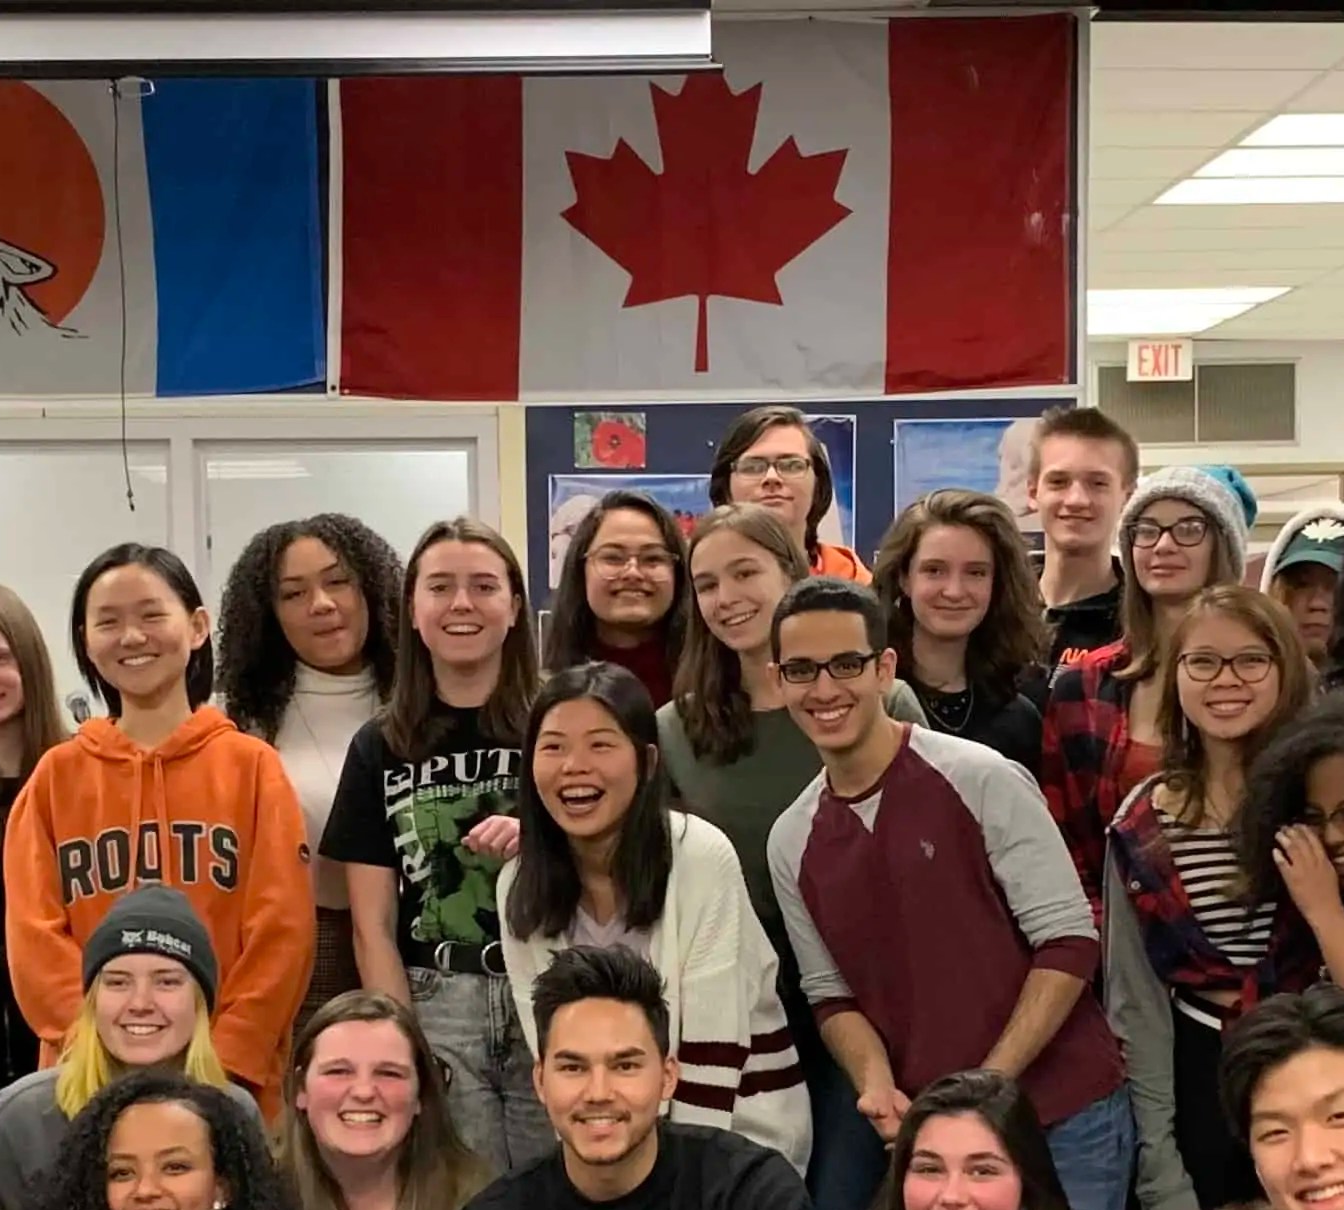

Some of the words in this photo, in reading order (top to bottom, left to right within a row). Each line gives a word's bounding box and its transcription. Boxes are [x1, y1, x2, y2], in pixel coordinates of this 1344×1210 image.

[1137, 344, 1183, 377] EXIT
[418, 748, 523, 786] PUT
[57, 821, 240, 907] ROOTS
